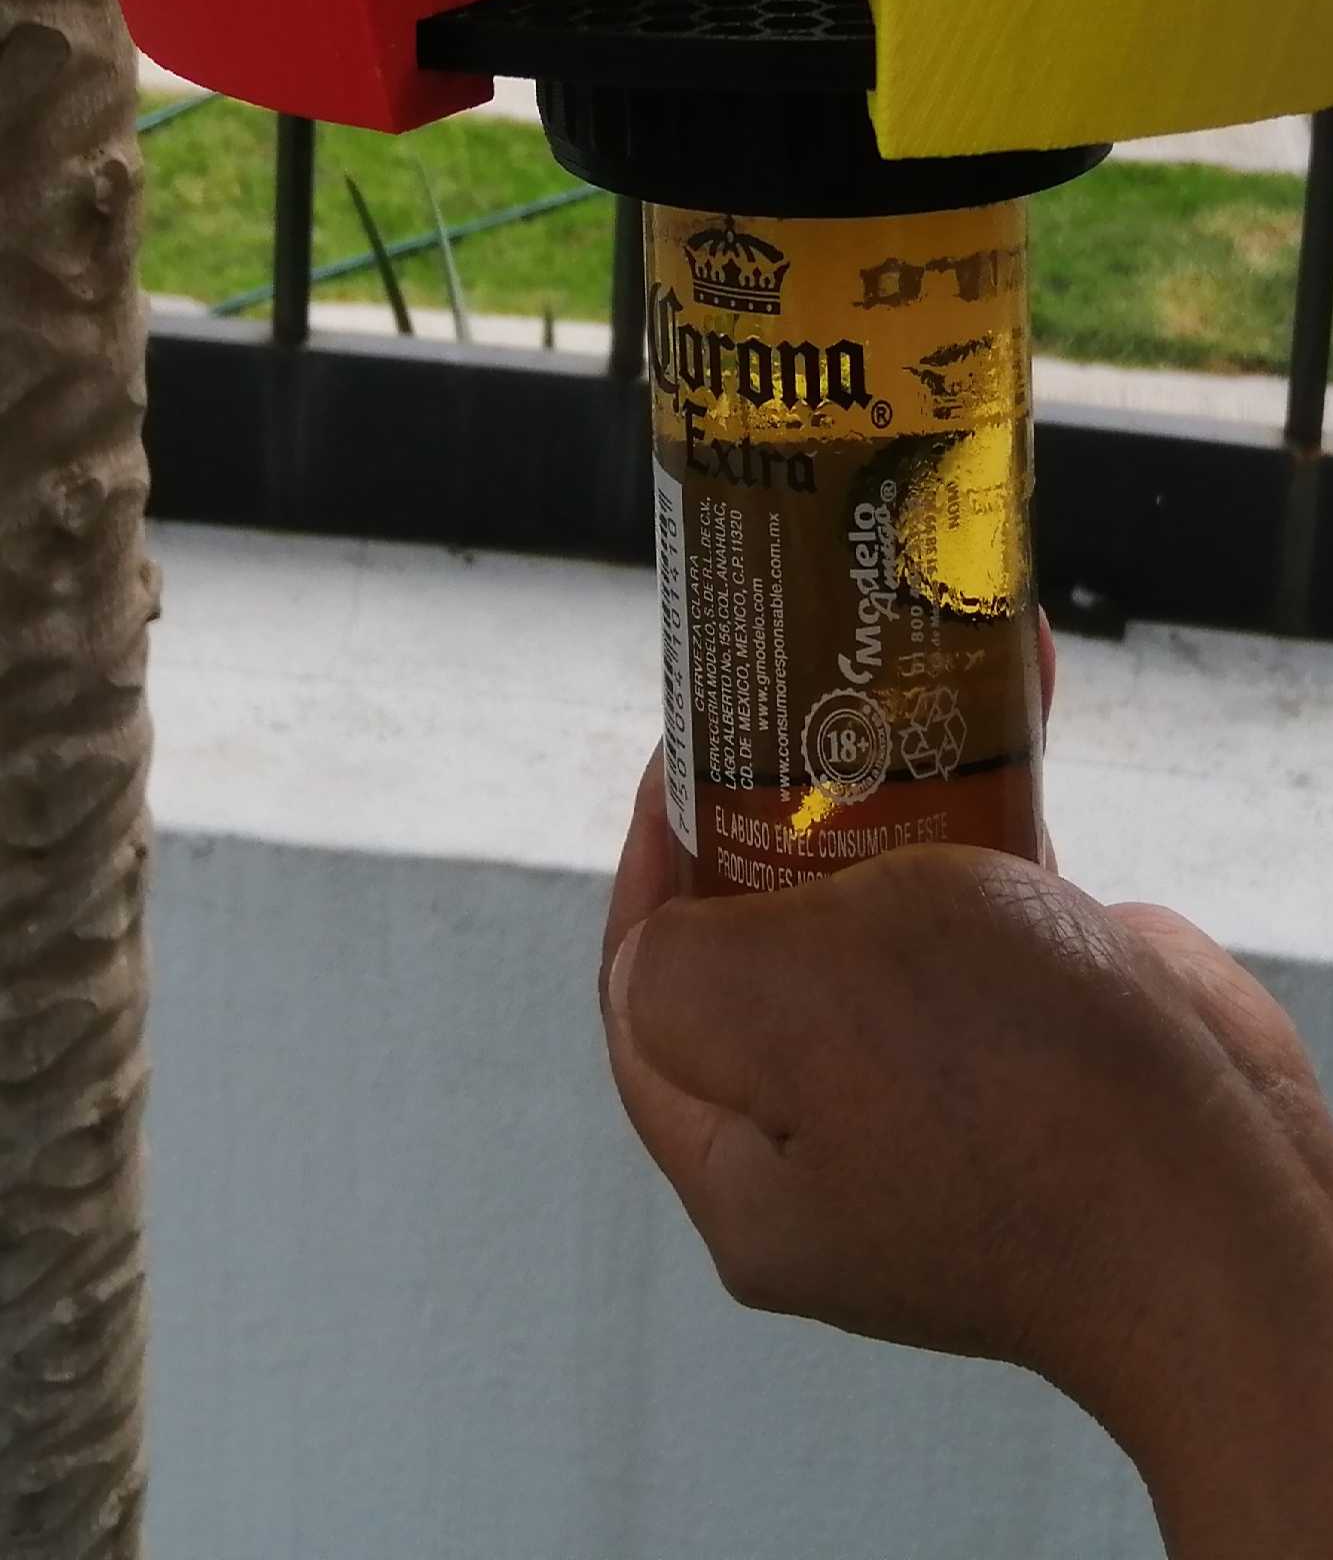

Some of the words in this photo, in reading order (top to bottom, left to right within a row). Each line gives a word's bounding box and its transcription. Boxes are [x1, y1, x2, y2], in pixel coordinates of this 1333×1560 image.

[647, 282, 873, 413] Corona
[682, 397, 818, 493] Extra
[700, 526, 711, 549] DE
[713, 502, 728, 581] ANAHUAC,
[689, 555, 701, 621] CLARA
[703, 582, 714, 602] DE
[837, 503, 882, 684] Modelo
[733, 589, 748, 658] MEXICO,
[752, 578, 770, 731] www.gmodelo.com
[769, 511, 791, 803] www.consumoresponsable.com.mx
[693, 624, 705, 712] CERVEZA
[736, 662, 751, 732] MEXICO,
[707, 690, 721, 783] CERVECERIA
[721, 675, 735, 746] ALBERTO
[723, 746, 737, 790] LAGO
[739, 735, 752, 759] DE
[740, 761, 754, 790] CD.
[827, 728, 869, 763] 18+
[715, 805, 729, 837] EL
[731, 811, 770, 851] ABUSO
[818, 826, 889, 858] CONSUMO
[717, 846, 775, 893] PRODUCTO
